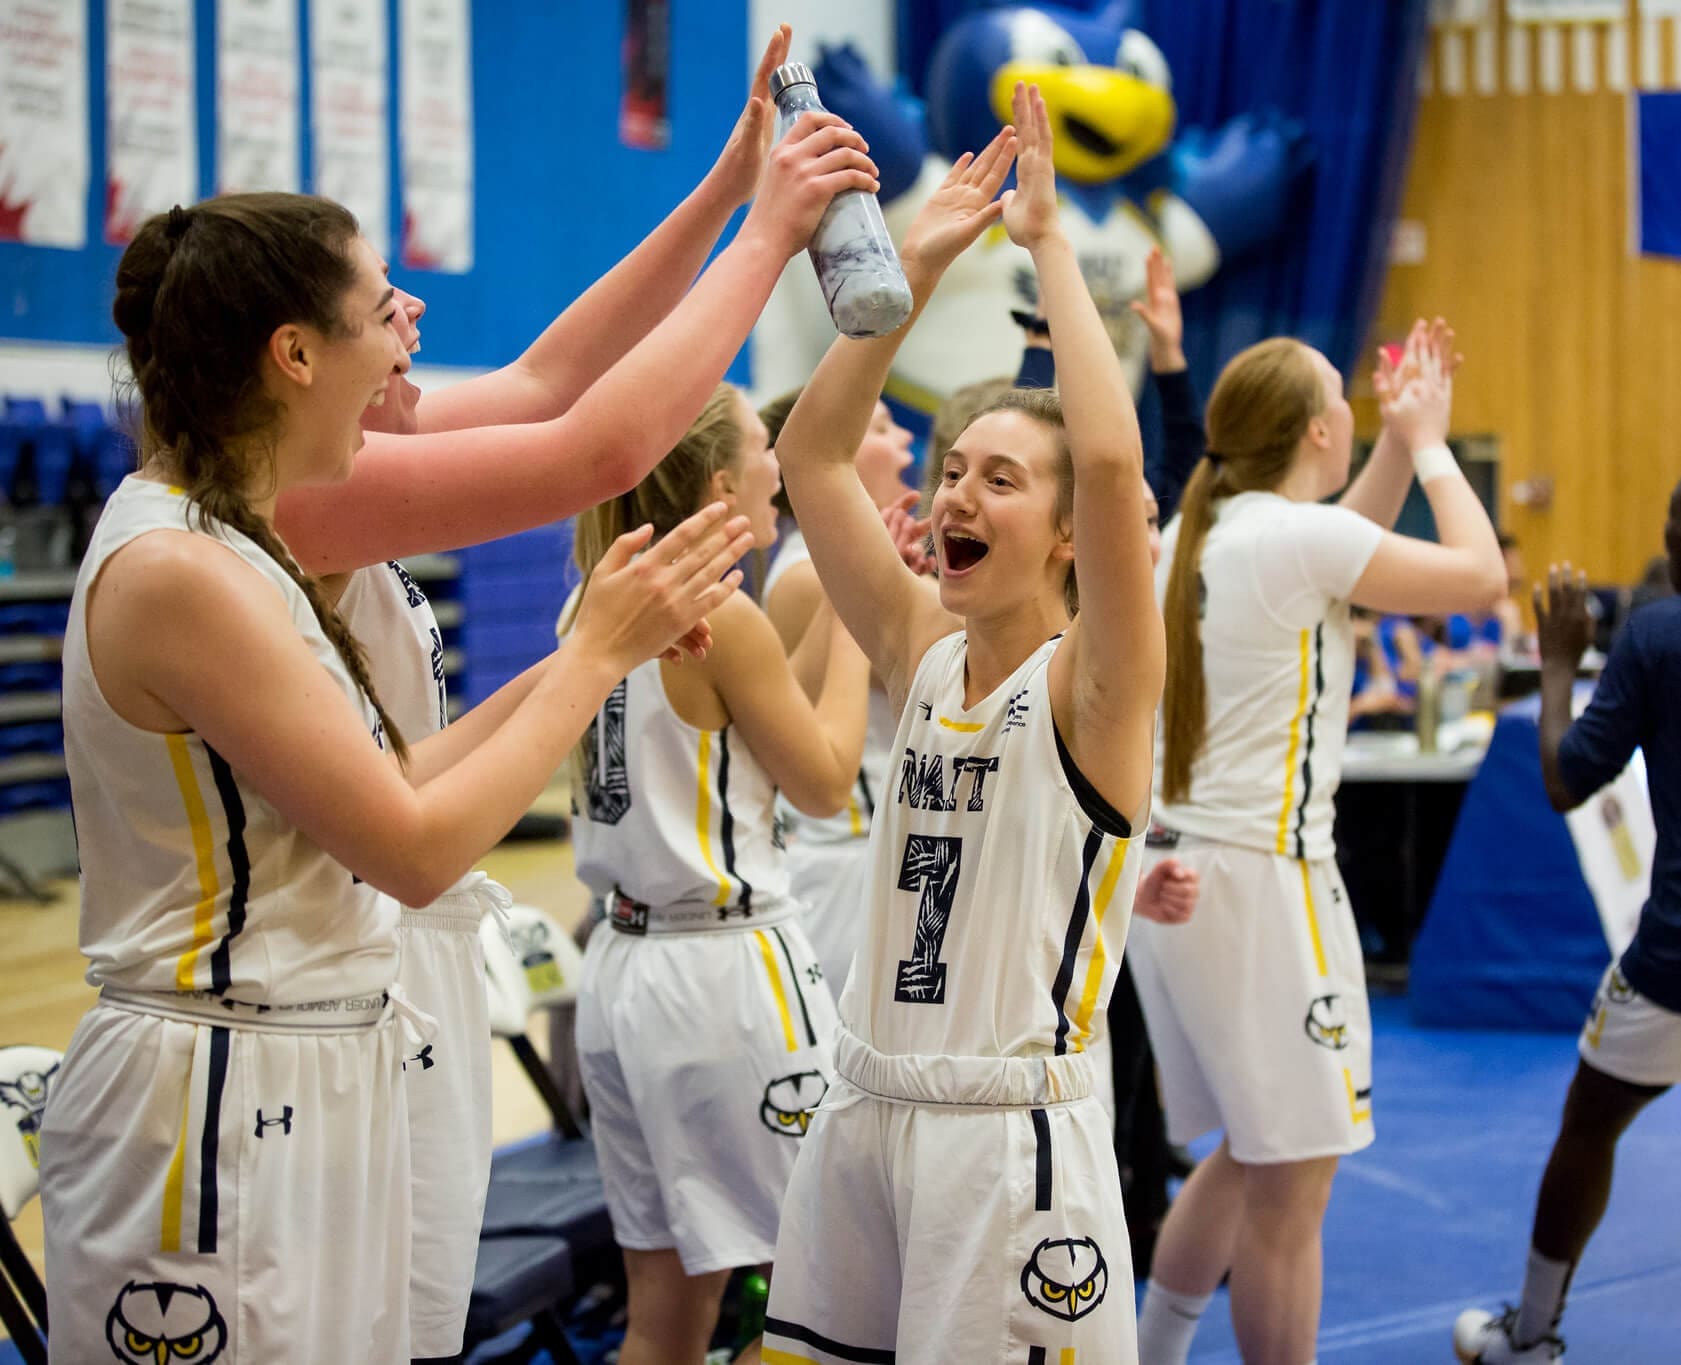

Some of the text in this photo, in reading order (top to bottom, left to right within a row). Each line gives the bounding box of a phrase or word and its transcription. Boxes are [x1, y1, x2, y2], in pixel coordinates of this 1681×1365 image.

[898, 748, 999, 811] NAIT
[894, 834, 963, 1004] 7
[344, 997, 381, 1011] UNDER
